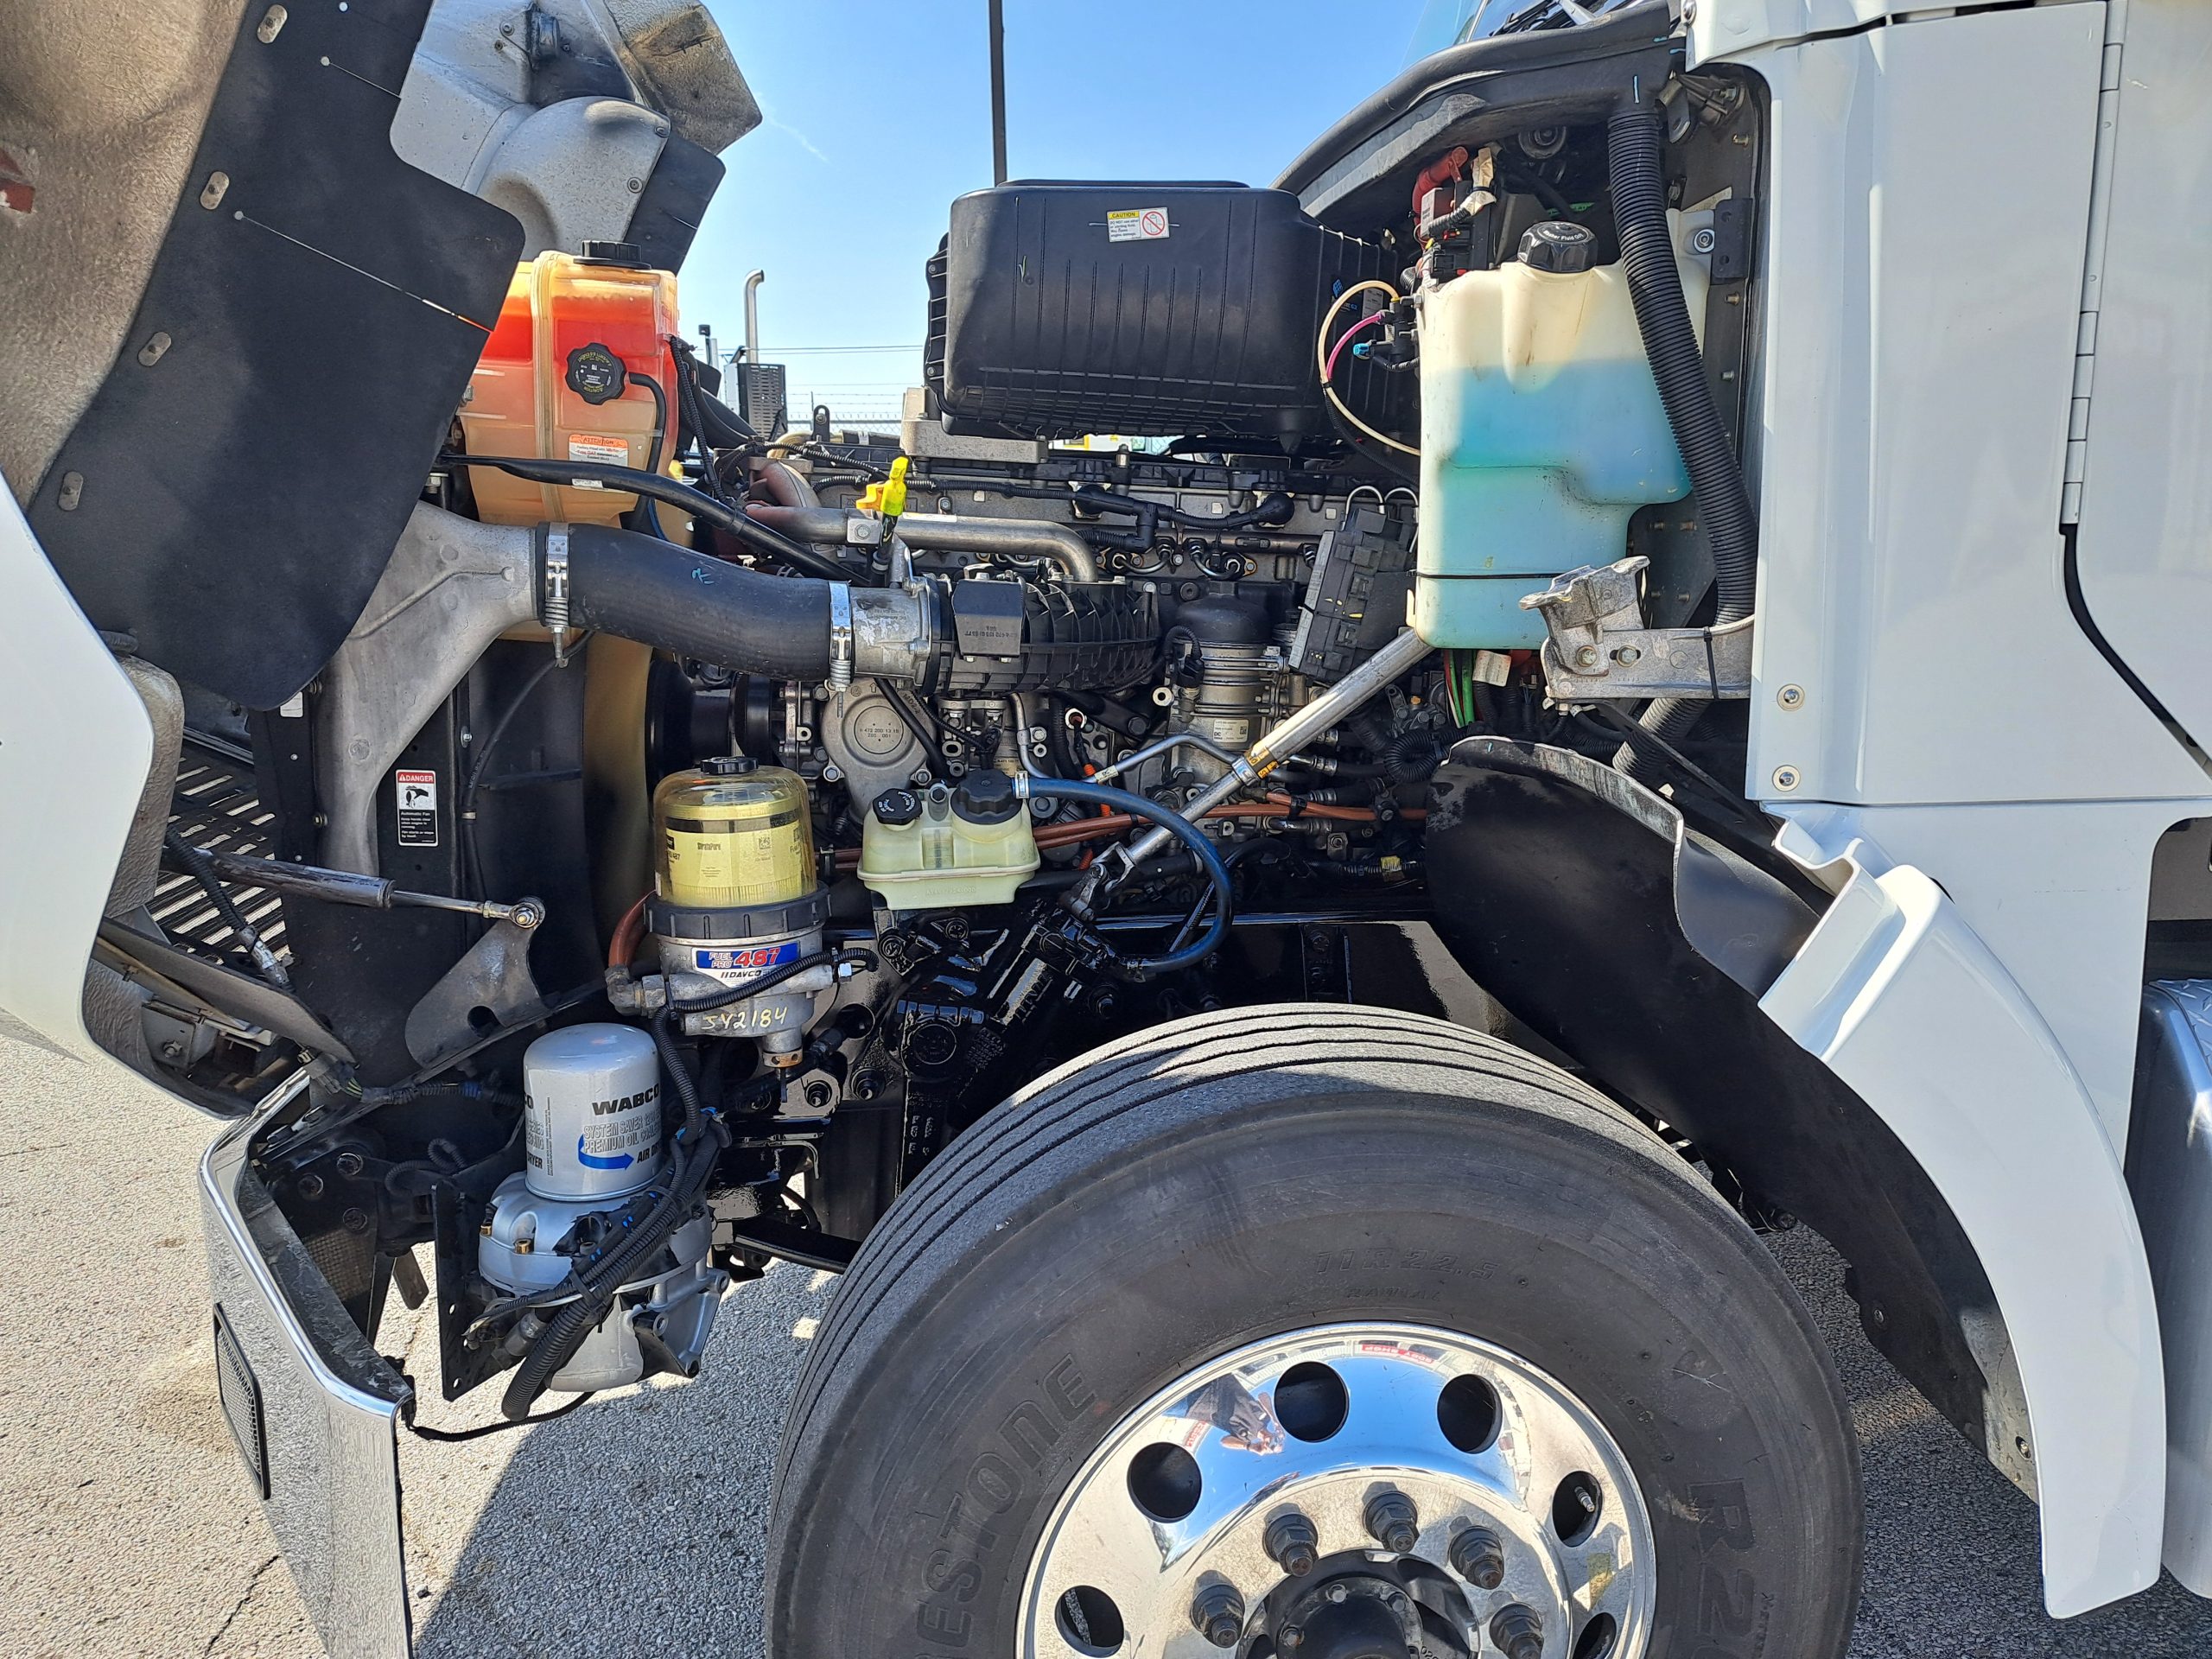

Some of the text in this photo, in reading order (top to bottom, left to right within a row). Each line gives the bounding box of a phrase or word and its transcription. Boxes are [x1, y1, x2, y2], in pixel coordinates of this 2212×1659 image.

[709, 952, 733, 961] FUEL
[734, 947, 781, 967] 487
[592, 1083, 659, 1116] WABCO
[583, 1122, 619, 1140] SYSTEM
[620, 1116, 643, 1134] SAVER
[584, 1135, 625, 1154] PREMIUM
[626, 1132, 639, 1147] OIL
[637, 1147, 650, 1163] AIR
[915, 1352, 1098, 1659] ESTONE
[1681, 1478, 1757, 1659] R2
